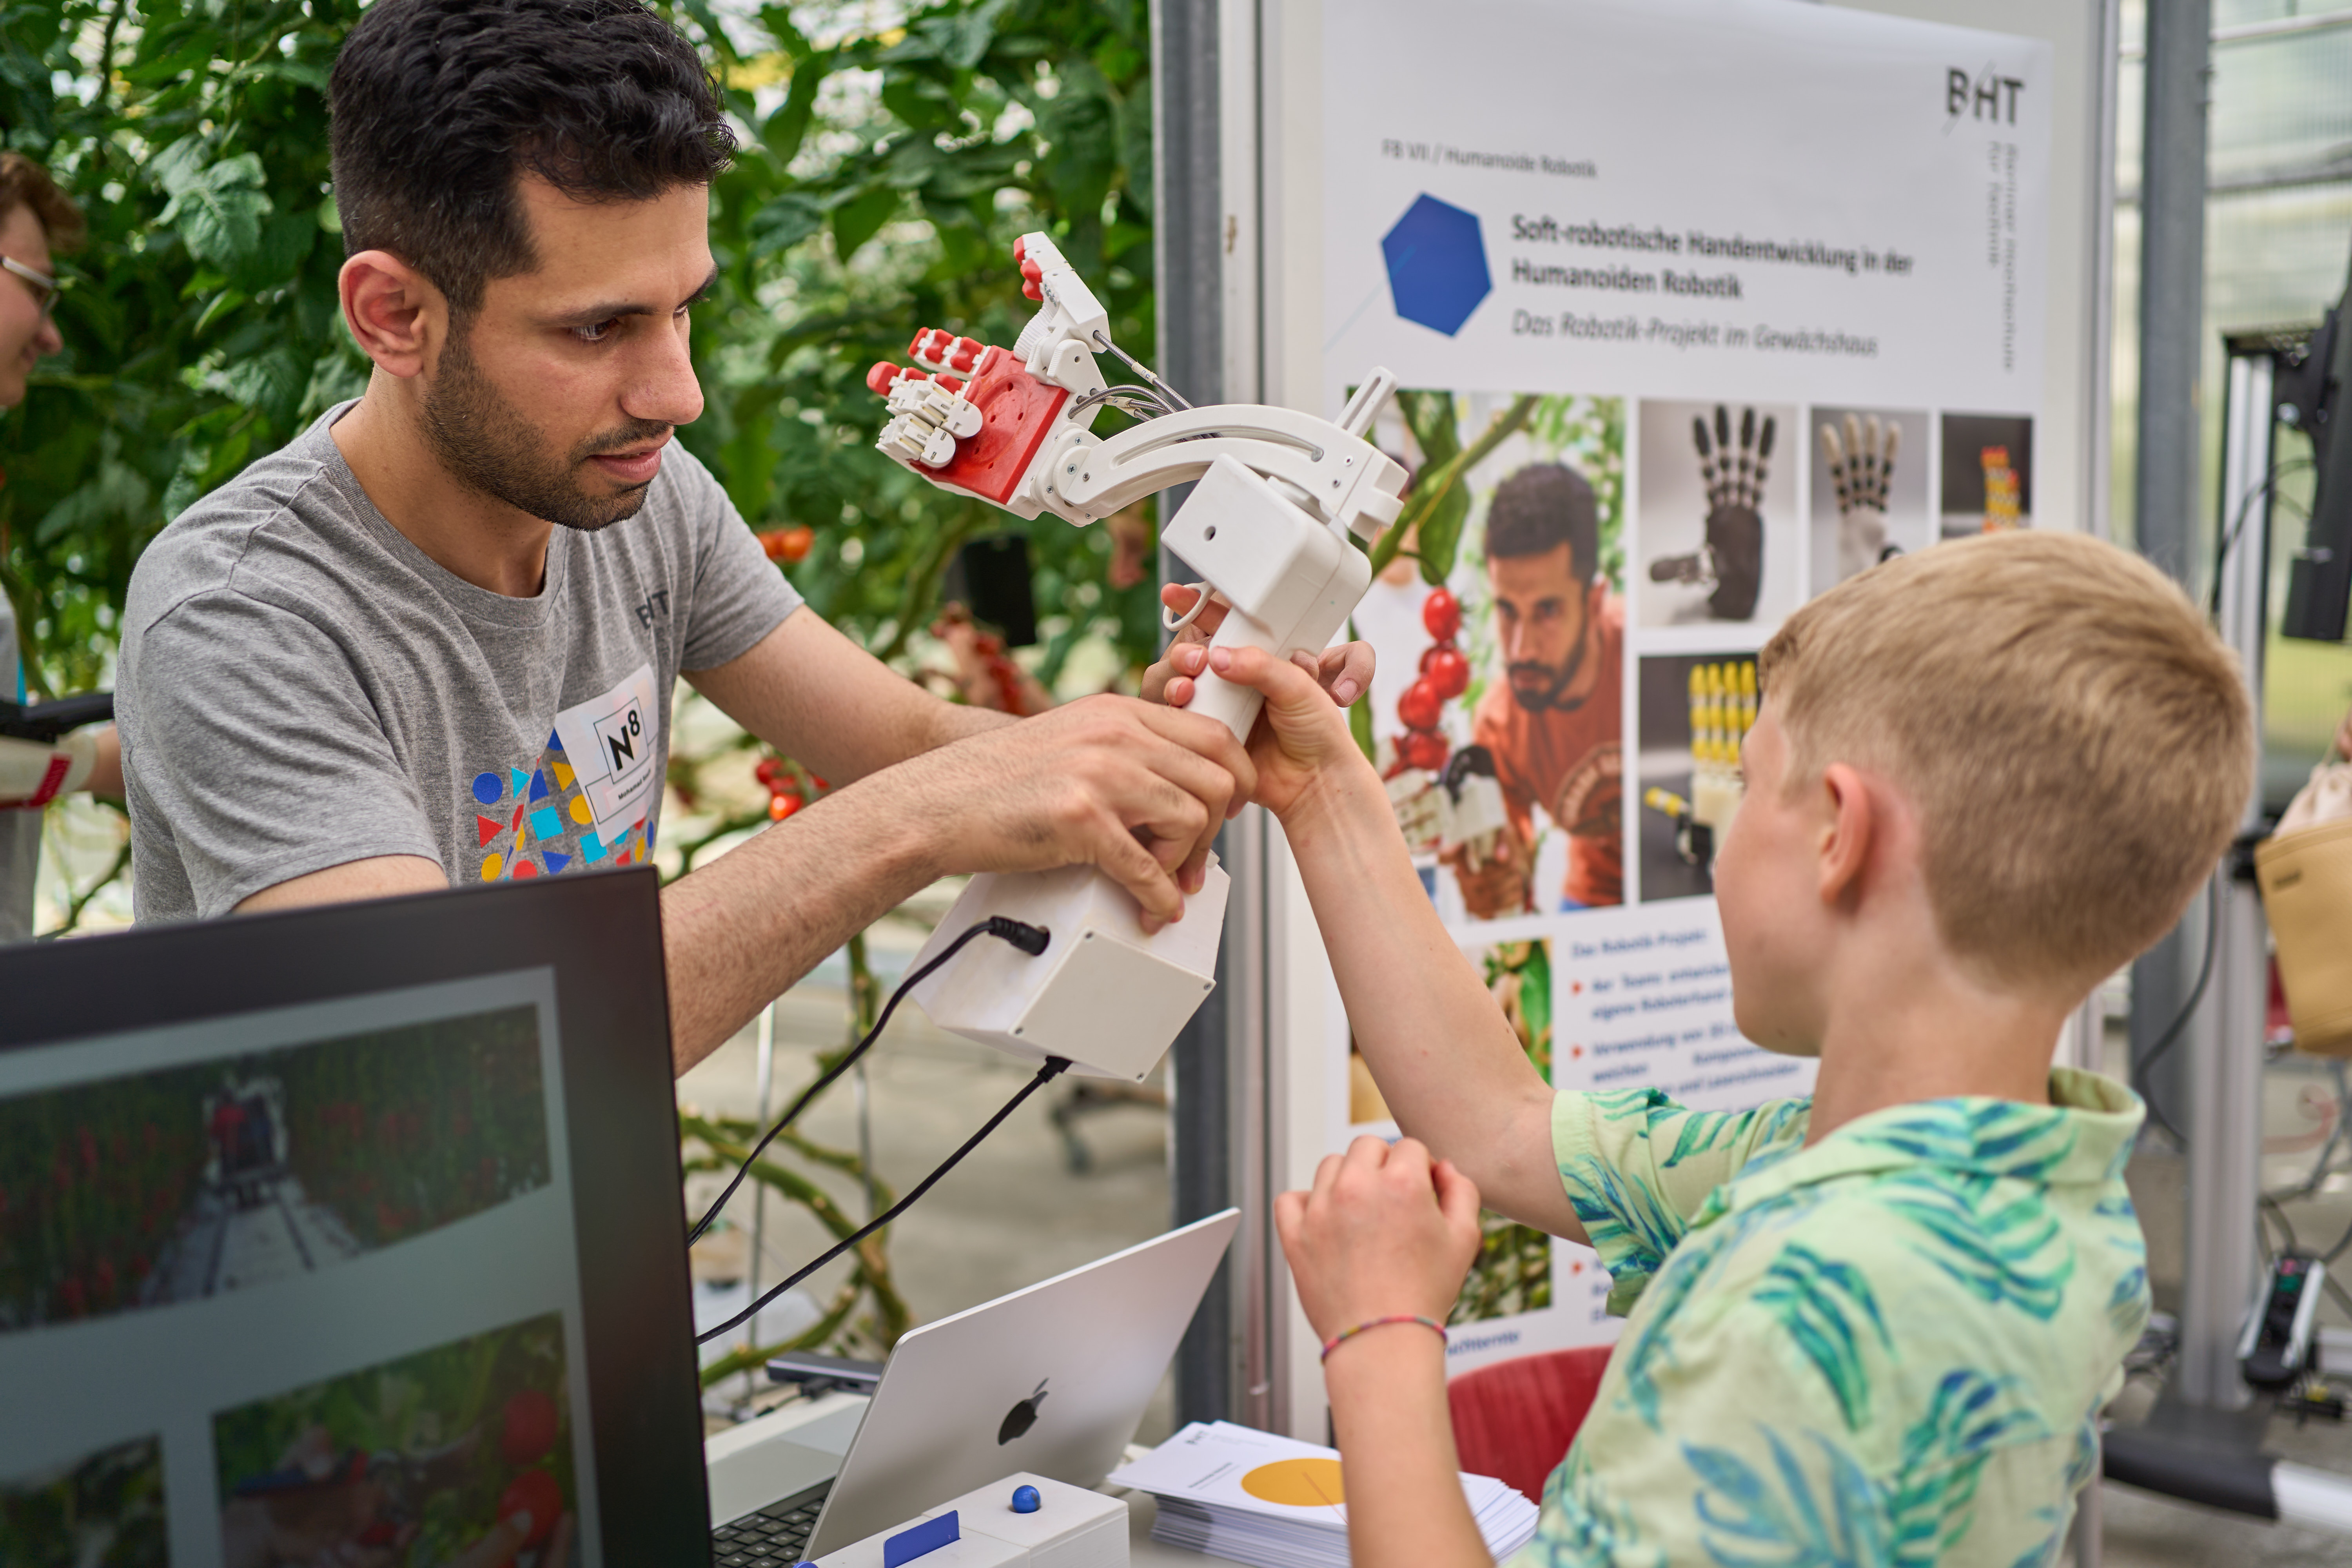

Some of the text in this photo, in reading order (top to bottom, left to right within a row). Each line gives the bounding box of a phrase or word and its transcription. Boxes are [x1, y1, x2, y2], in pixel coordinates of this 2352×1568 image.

[1947, 67, 2024, 125] BHT
[1540, 154, 1599, 180] Robotik
[1512, 214, 1913, 276] Soft-robotische Handentwicklung in der
[1512, 258, 1744, 300] Humanoiden Robotik
[1512, 309, 1879, 360] Das Robotik-Projekt im Gewächshaus
